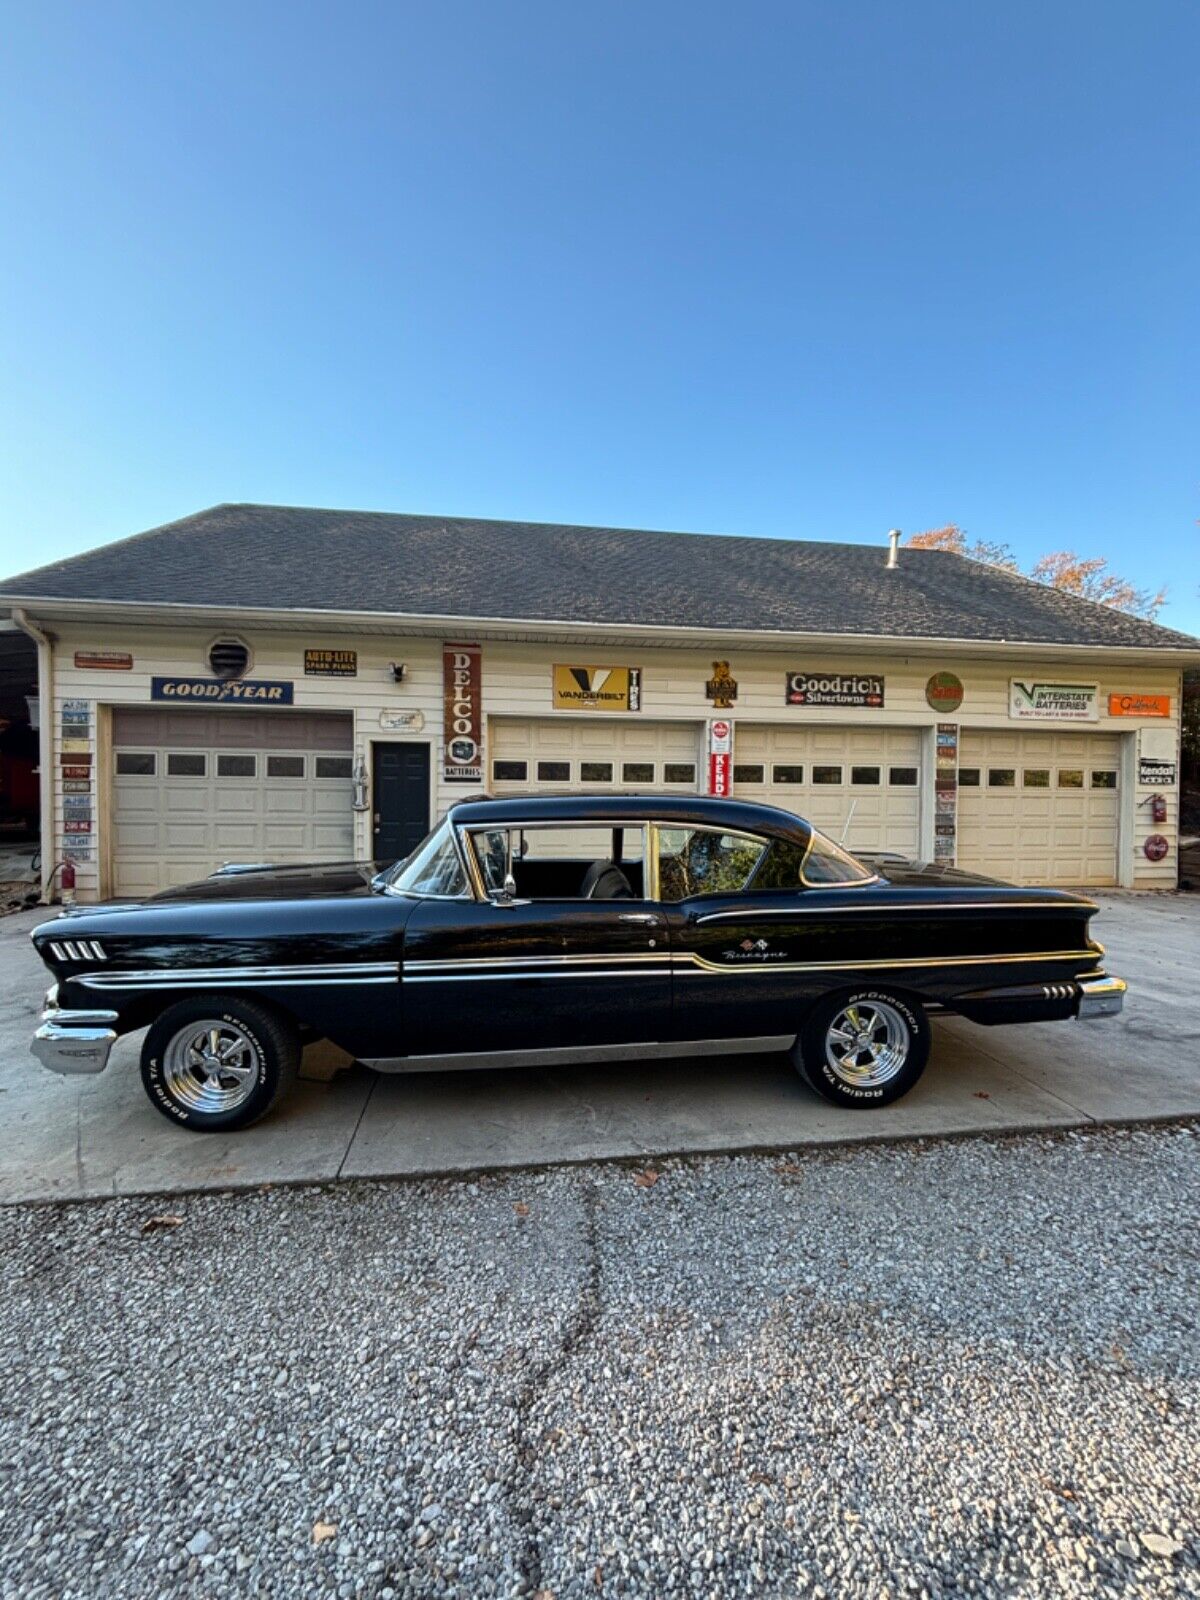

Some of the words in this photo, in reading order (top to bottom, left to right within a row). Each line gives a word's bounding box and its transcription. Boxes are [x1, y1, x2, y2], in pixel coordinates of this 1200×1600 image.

[162, 682, 283, 699] GOODYEAR
[791, 675, 881, 694] Goodrich
[453, 653, 472, 734] DELCO
[558, 690, 626, 700] VANDERBILT
[806, 692, 865, 703] Silvertowns
[1037, 691, 1095, 702] INTERSTATE
[1035, 701, 1087, 710] BATTERIES
[445, 767, 480, 777] BATTERIES
[715, 755, 725, 797] KEND
[1140, 766, 1174, 776] Kendall
[149, 1058, 158, 1079] T/A
[822, 1064, 836, 1085] T/A
[838, 1083, 884, 1098] Radial
[153, 1085, 189, 1120] Radial
